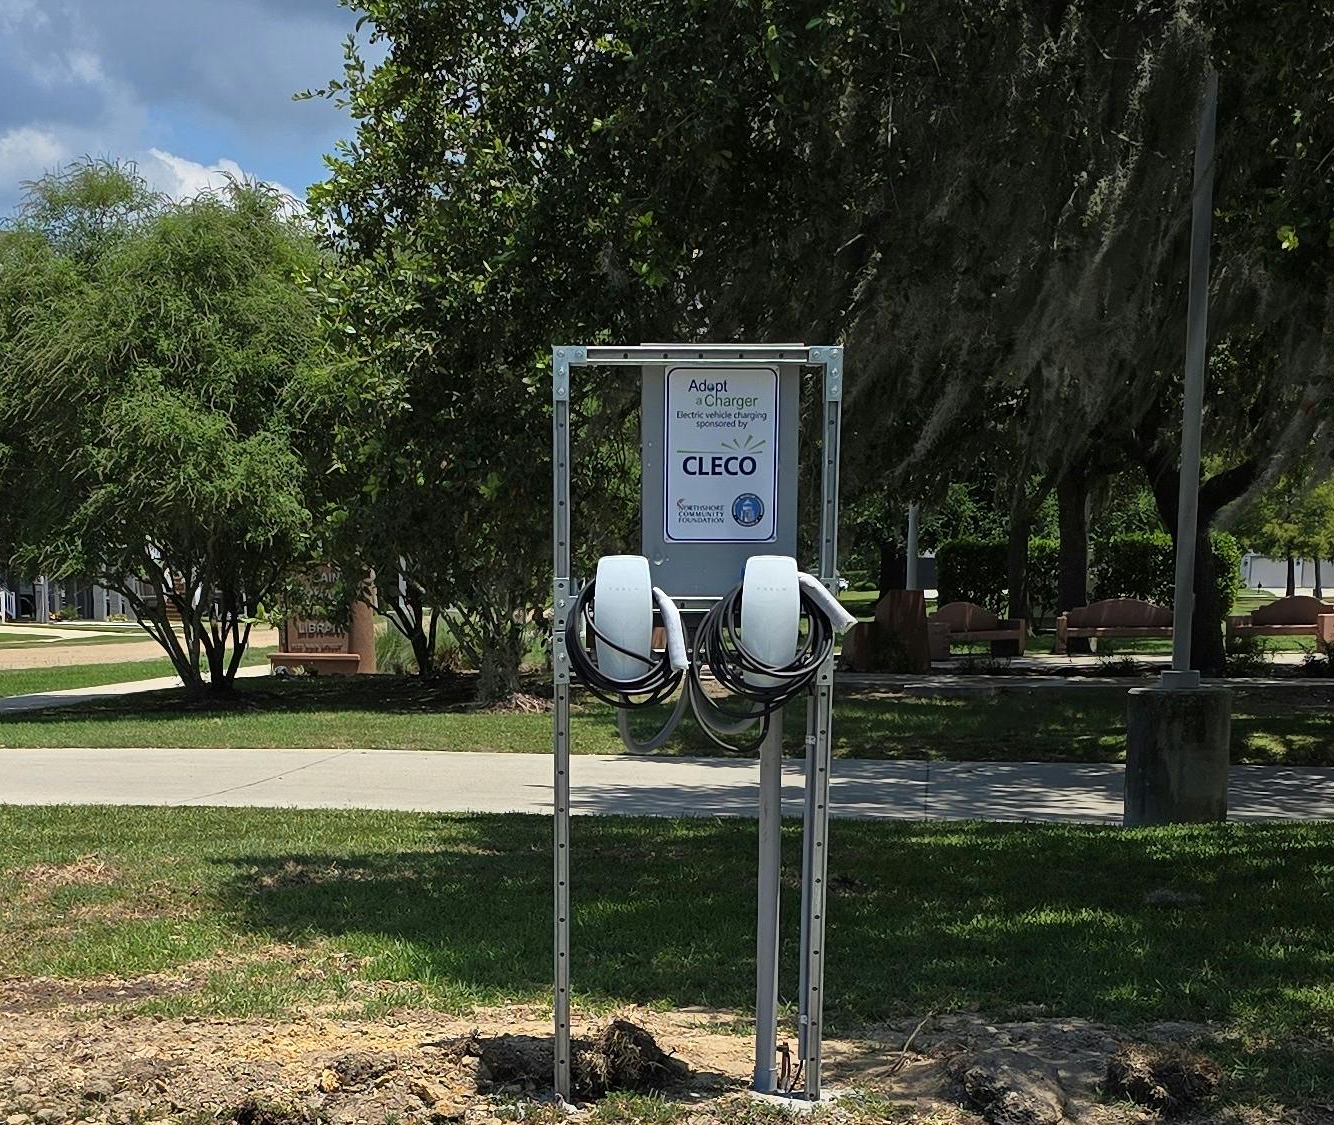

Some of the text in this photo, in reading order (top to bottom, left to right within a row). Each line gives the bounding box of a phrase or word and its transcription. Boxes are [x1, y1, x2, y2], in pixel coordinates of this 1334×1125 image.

[688, 379, 728, 398] Adopt
[696, 394, 759, 410] a Charger
[676, 410, 767, 422] Electric vehicle charging
[696, 420, 748, 430] sponsored by
[682, 456, 757, 476] CLECO
